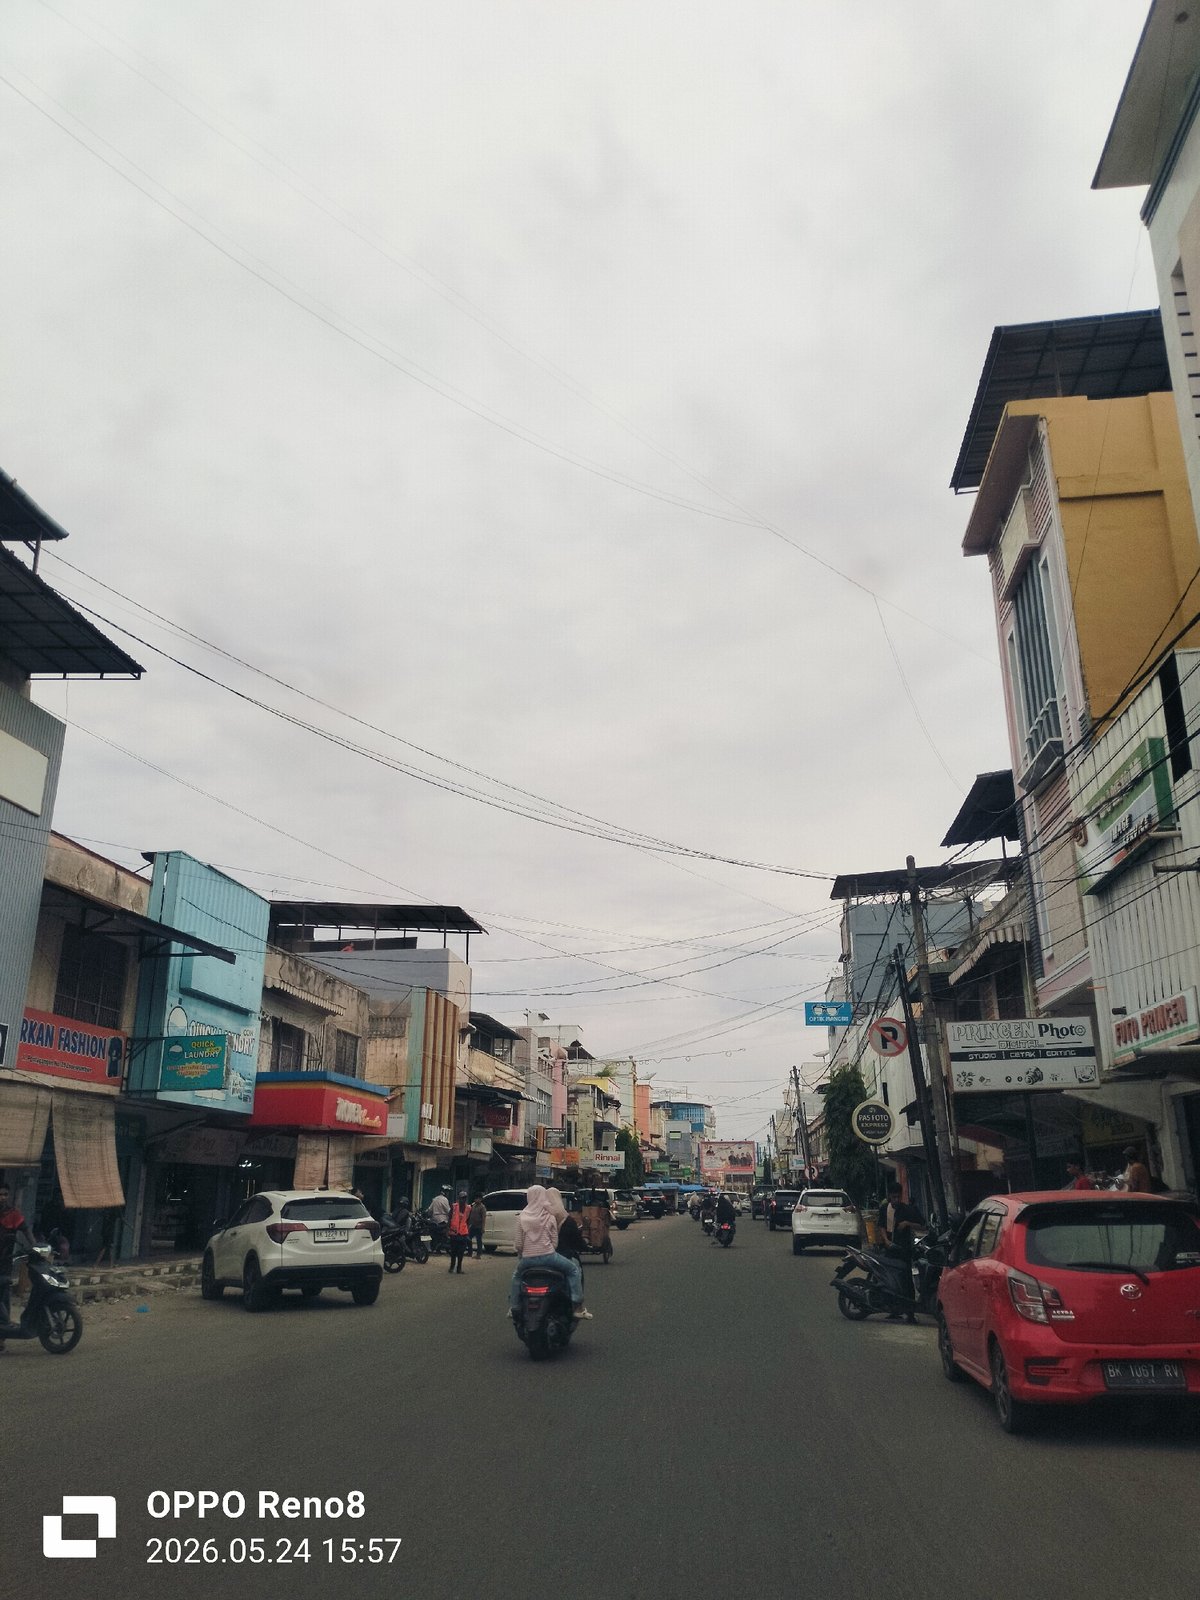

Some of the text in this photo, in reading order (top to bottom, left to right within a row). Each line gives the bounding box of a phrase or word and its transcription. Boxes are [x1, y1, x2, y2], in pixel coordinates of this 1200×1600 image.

[952, 1021, 1035, 1043] PRINCEN
[1115, 1017, 1139, 1047] FOTO
[20, 1017, 107, 1060] RKAN FASHION
[191, 1041, 215, 1049] QUICK
[184, 1050, 221, 1059] LAUNDRY
[968, 1052, 997, 1060] STUDIO
[595, 1153, 621, 1162] Rinnai
[1107, 1364, 1122, 1377] BK
[1164, 1363, 1179, 1377] RV
